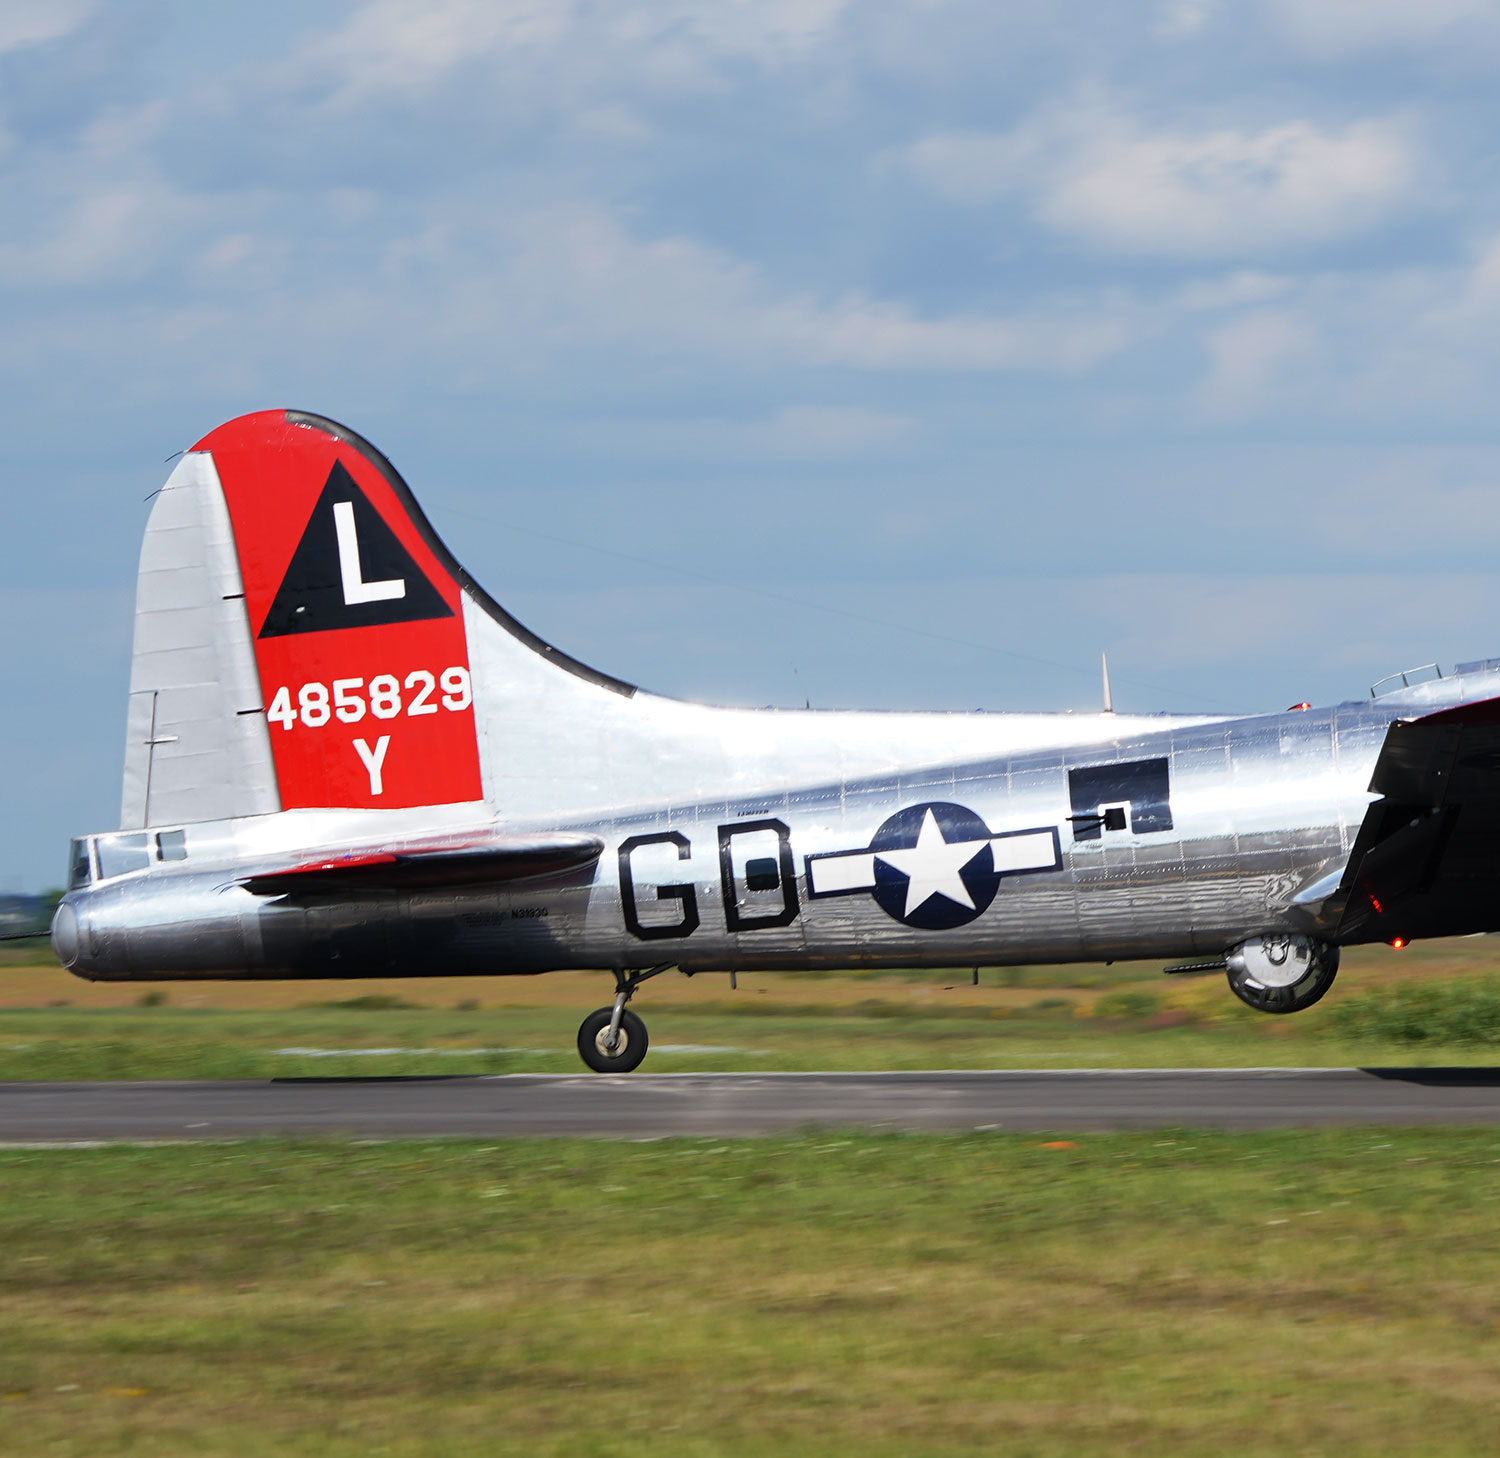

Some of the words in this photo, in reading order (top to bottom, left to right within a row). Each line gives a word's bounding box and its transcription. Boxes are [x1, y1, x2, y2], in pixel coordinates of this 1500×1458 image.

[333, 501, 405, 605] L
[267, 666, 473, 731] 485829
[352, 735, 391, 796] Y
